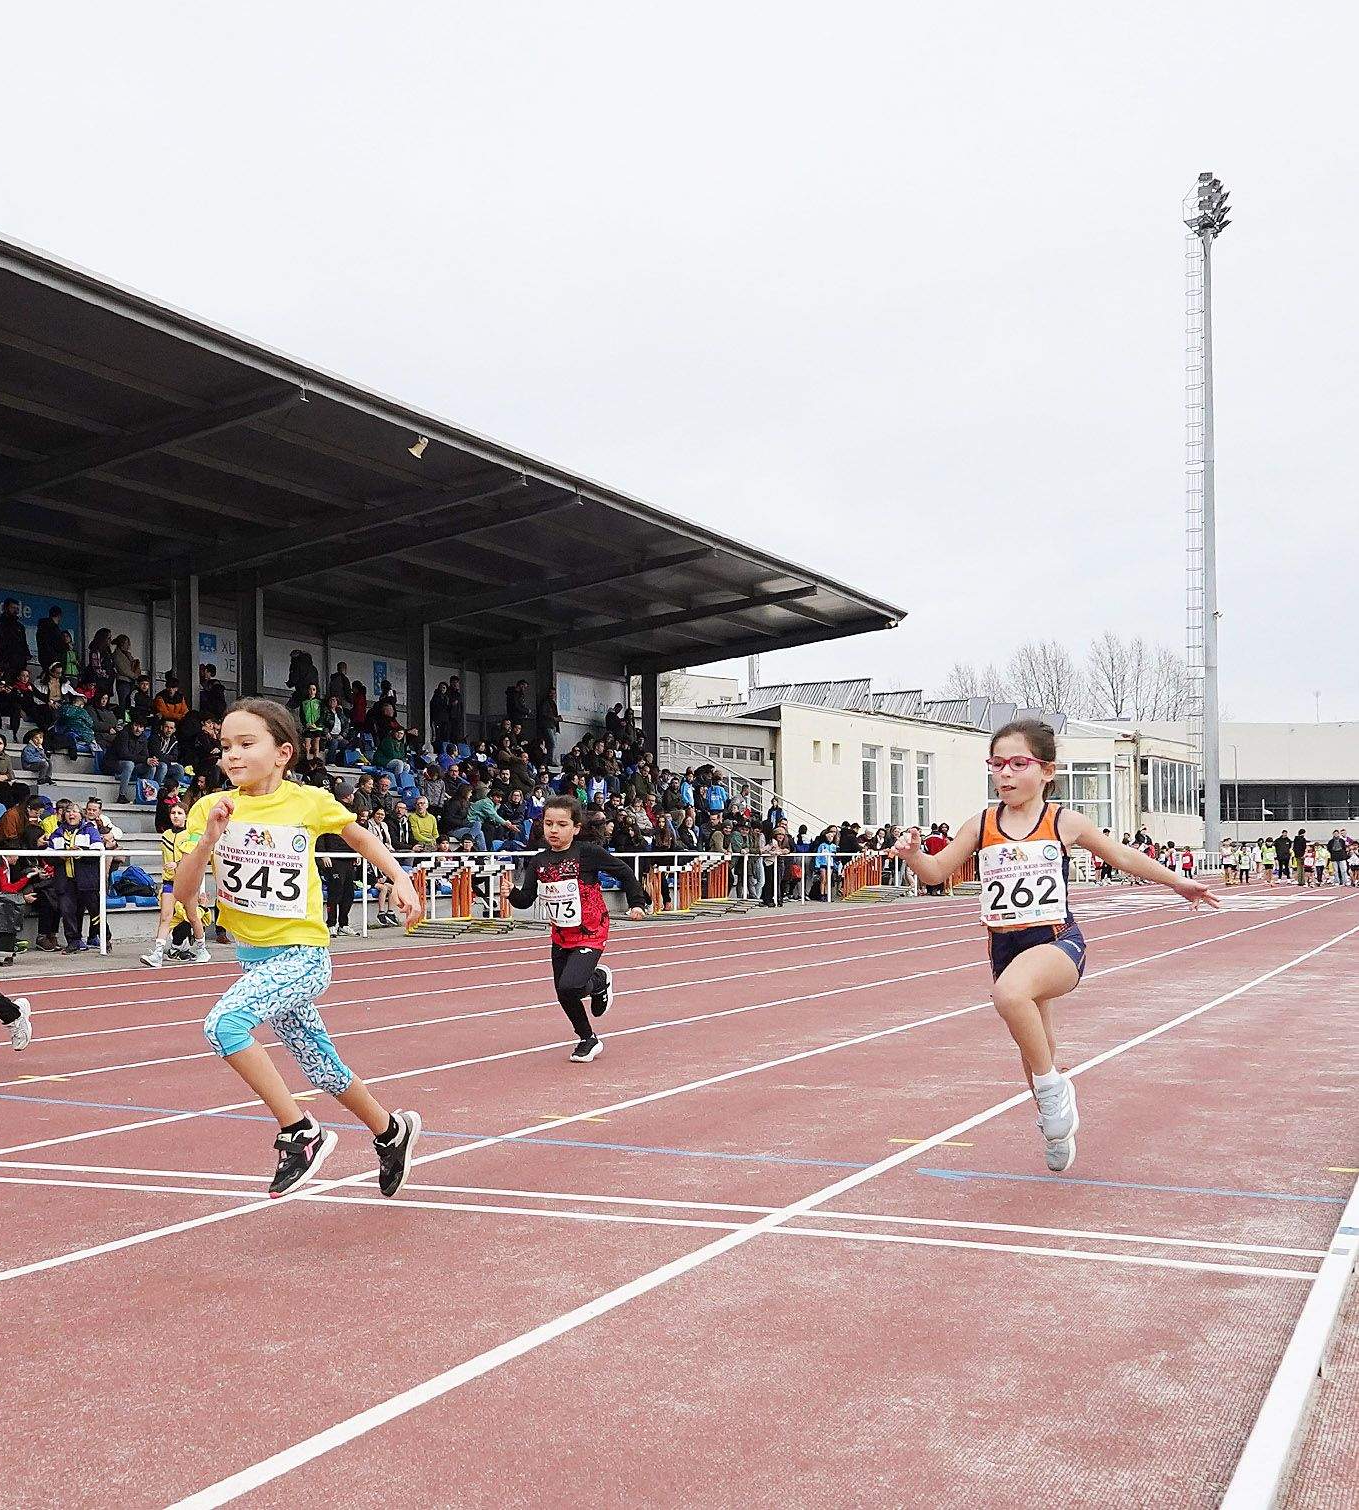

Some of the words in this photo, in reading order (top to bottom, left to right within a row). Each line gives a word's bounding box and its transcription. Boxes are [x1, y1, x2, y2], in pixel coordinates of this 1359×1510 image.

[222, 859, 302, 902] 343
[276, 860, 304, 869] SPORTS
[987, 875, 1059, 911] 262
